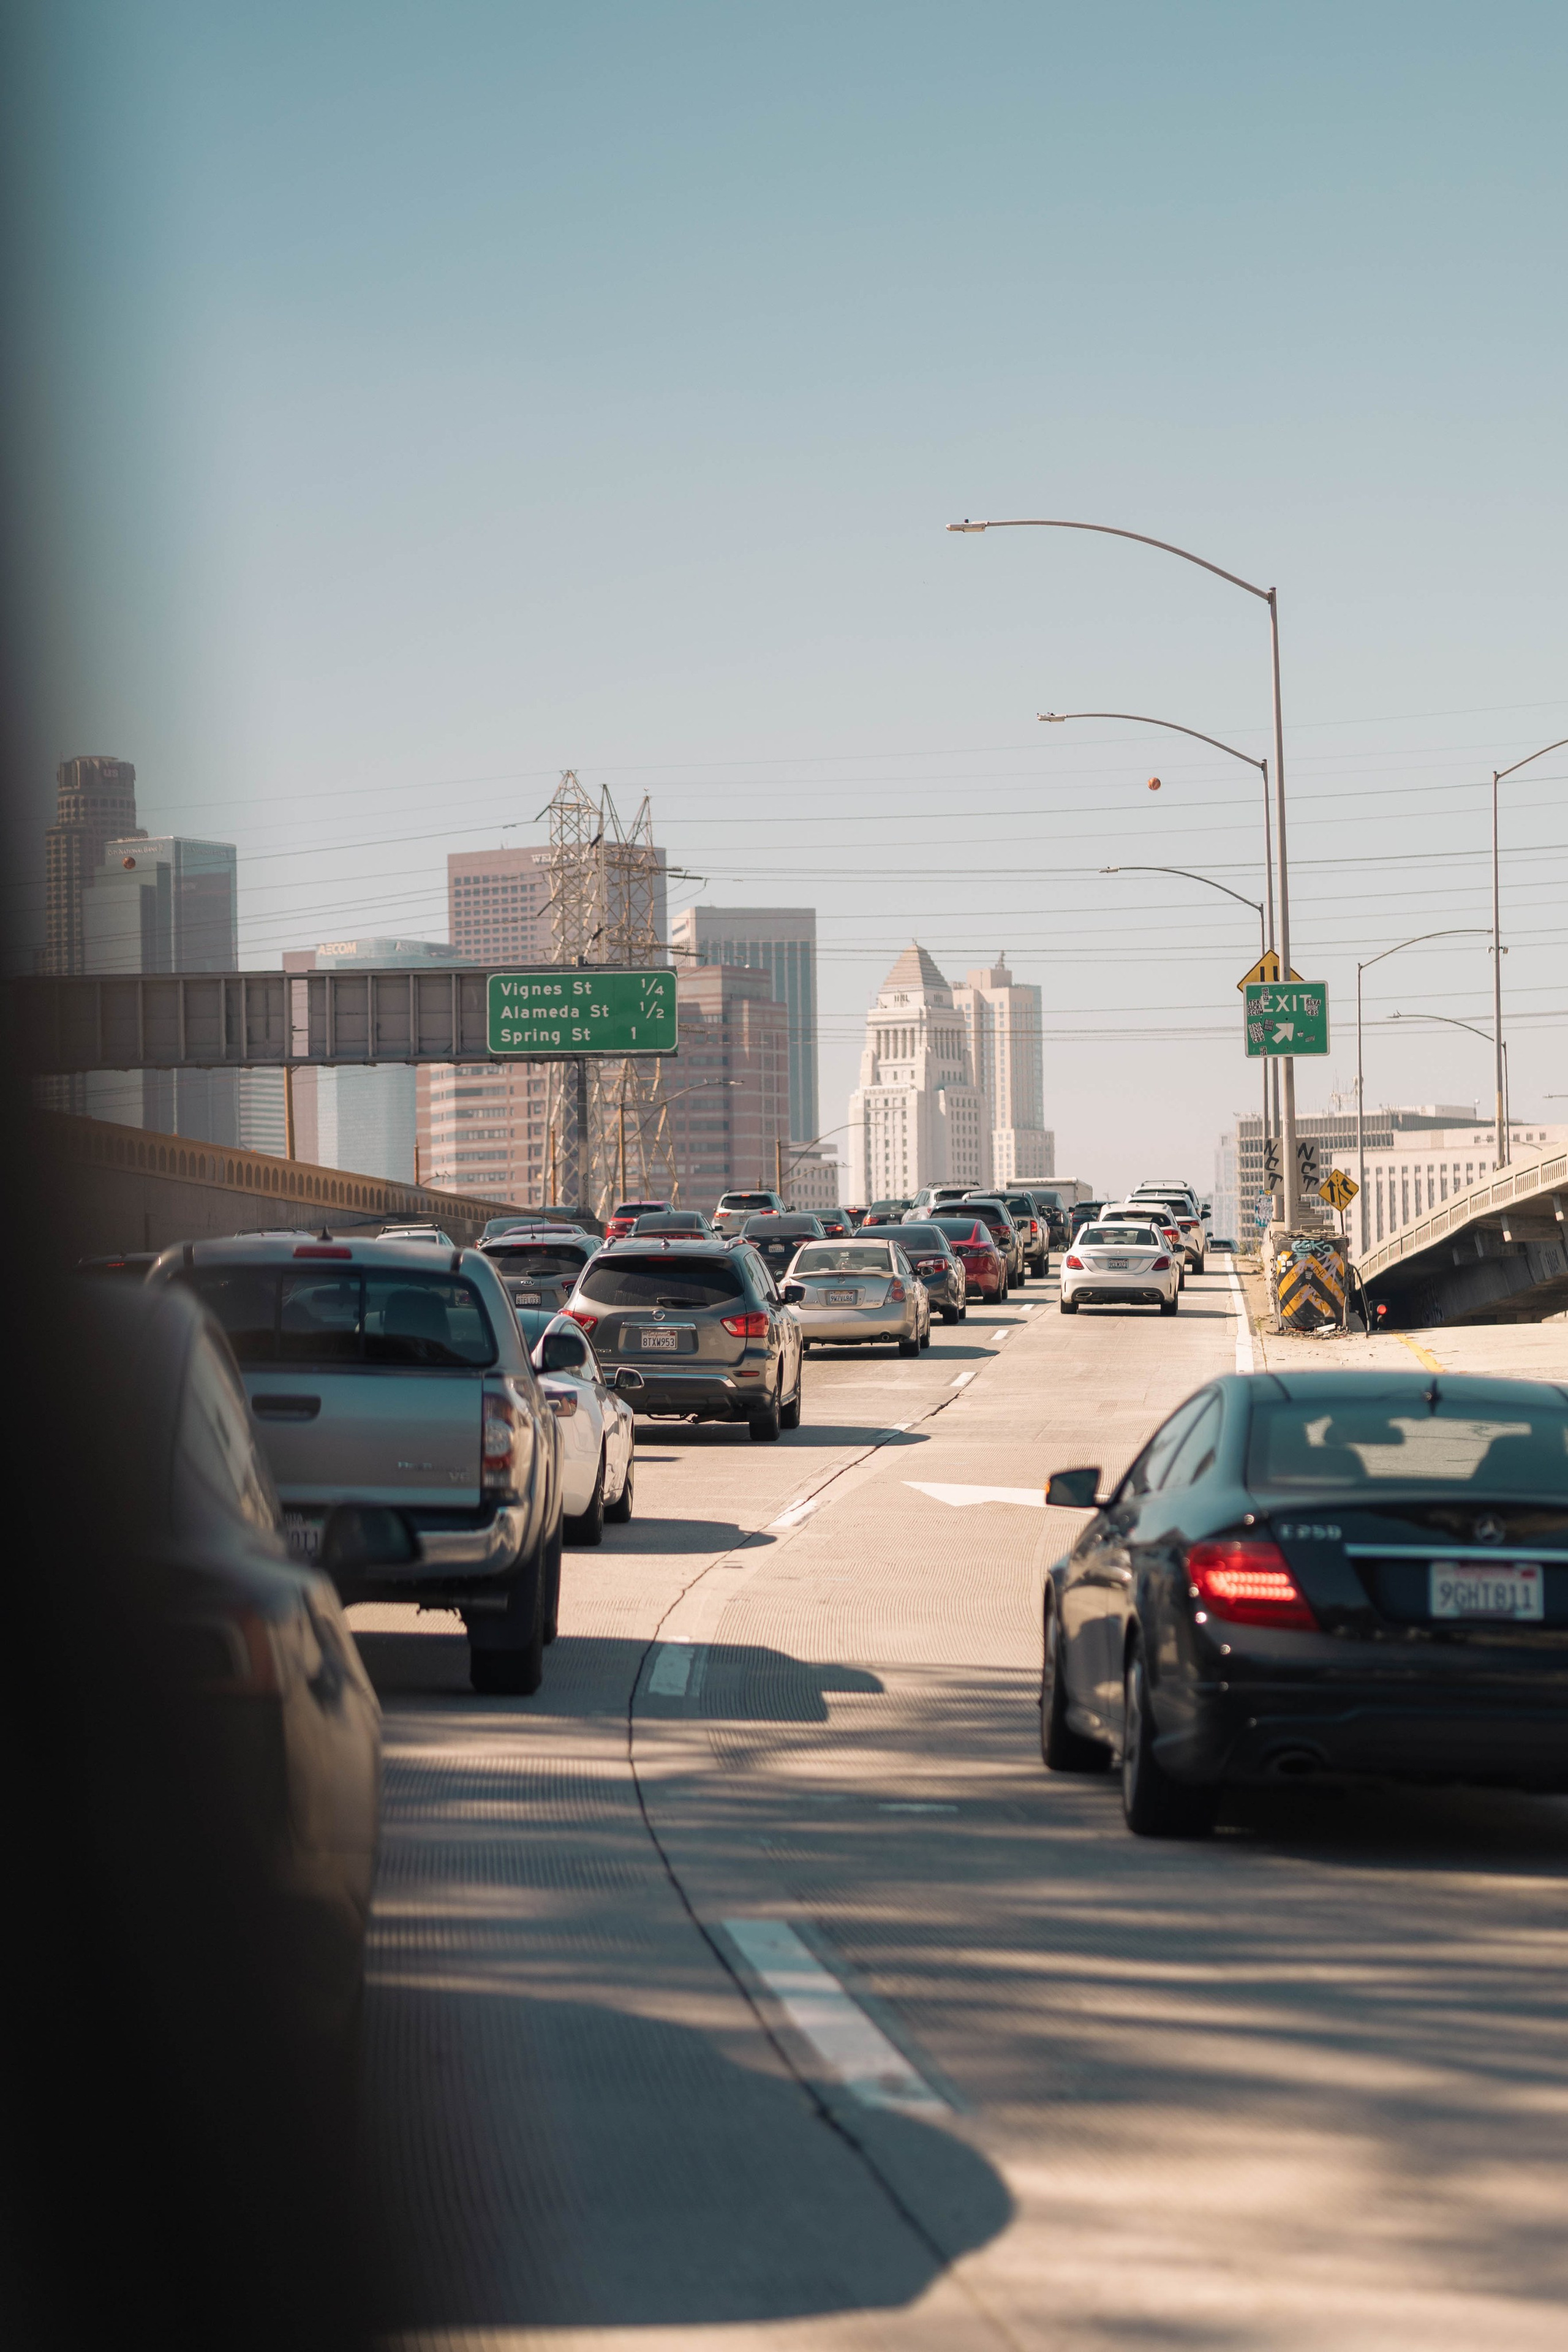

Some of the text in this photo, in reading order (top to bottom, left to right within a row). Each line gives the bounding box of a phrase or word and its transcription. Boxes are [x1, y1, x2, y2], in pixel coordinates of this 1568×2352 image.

[317, 941, 358, 956] AECOM
[500, 982, 562, 1000] Vignes
[573, 981, 592, 995] St
[1261, 994, 1311, 1012] EXIT
[500, 1005, 580, 1019] Alameda
[590, 1005, 609, 1017] St
[501, 1027, 636, 1045] Spring St 1
[643, 1338, 675, 1346] 8TXW953
